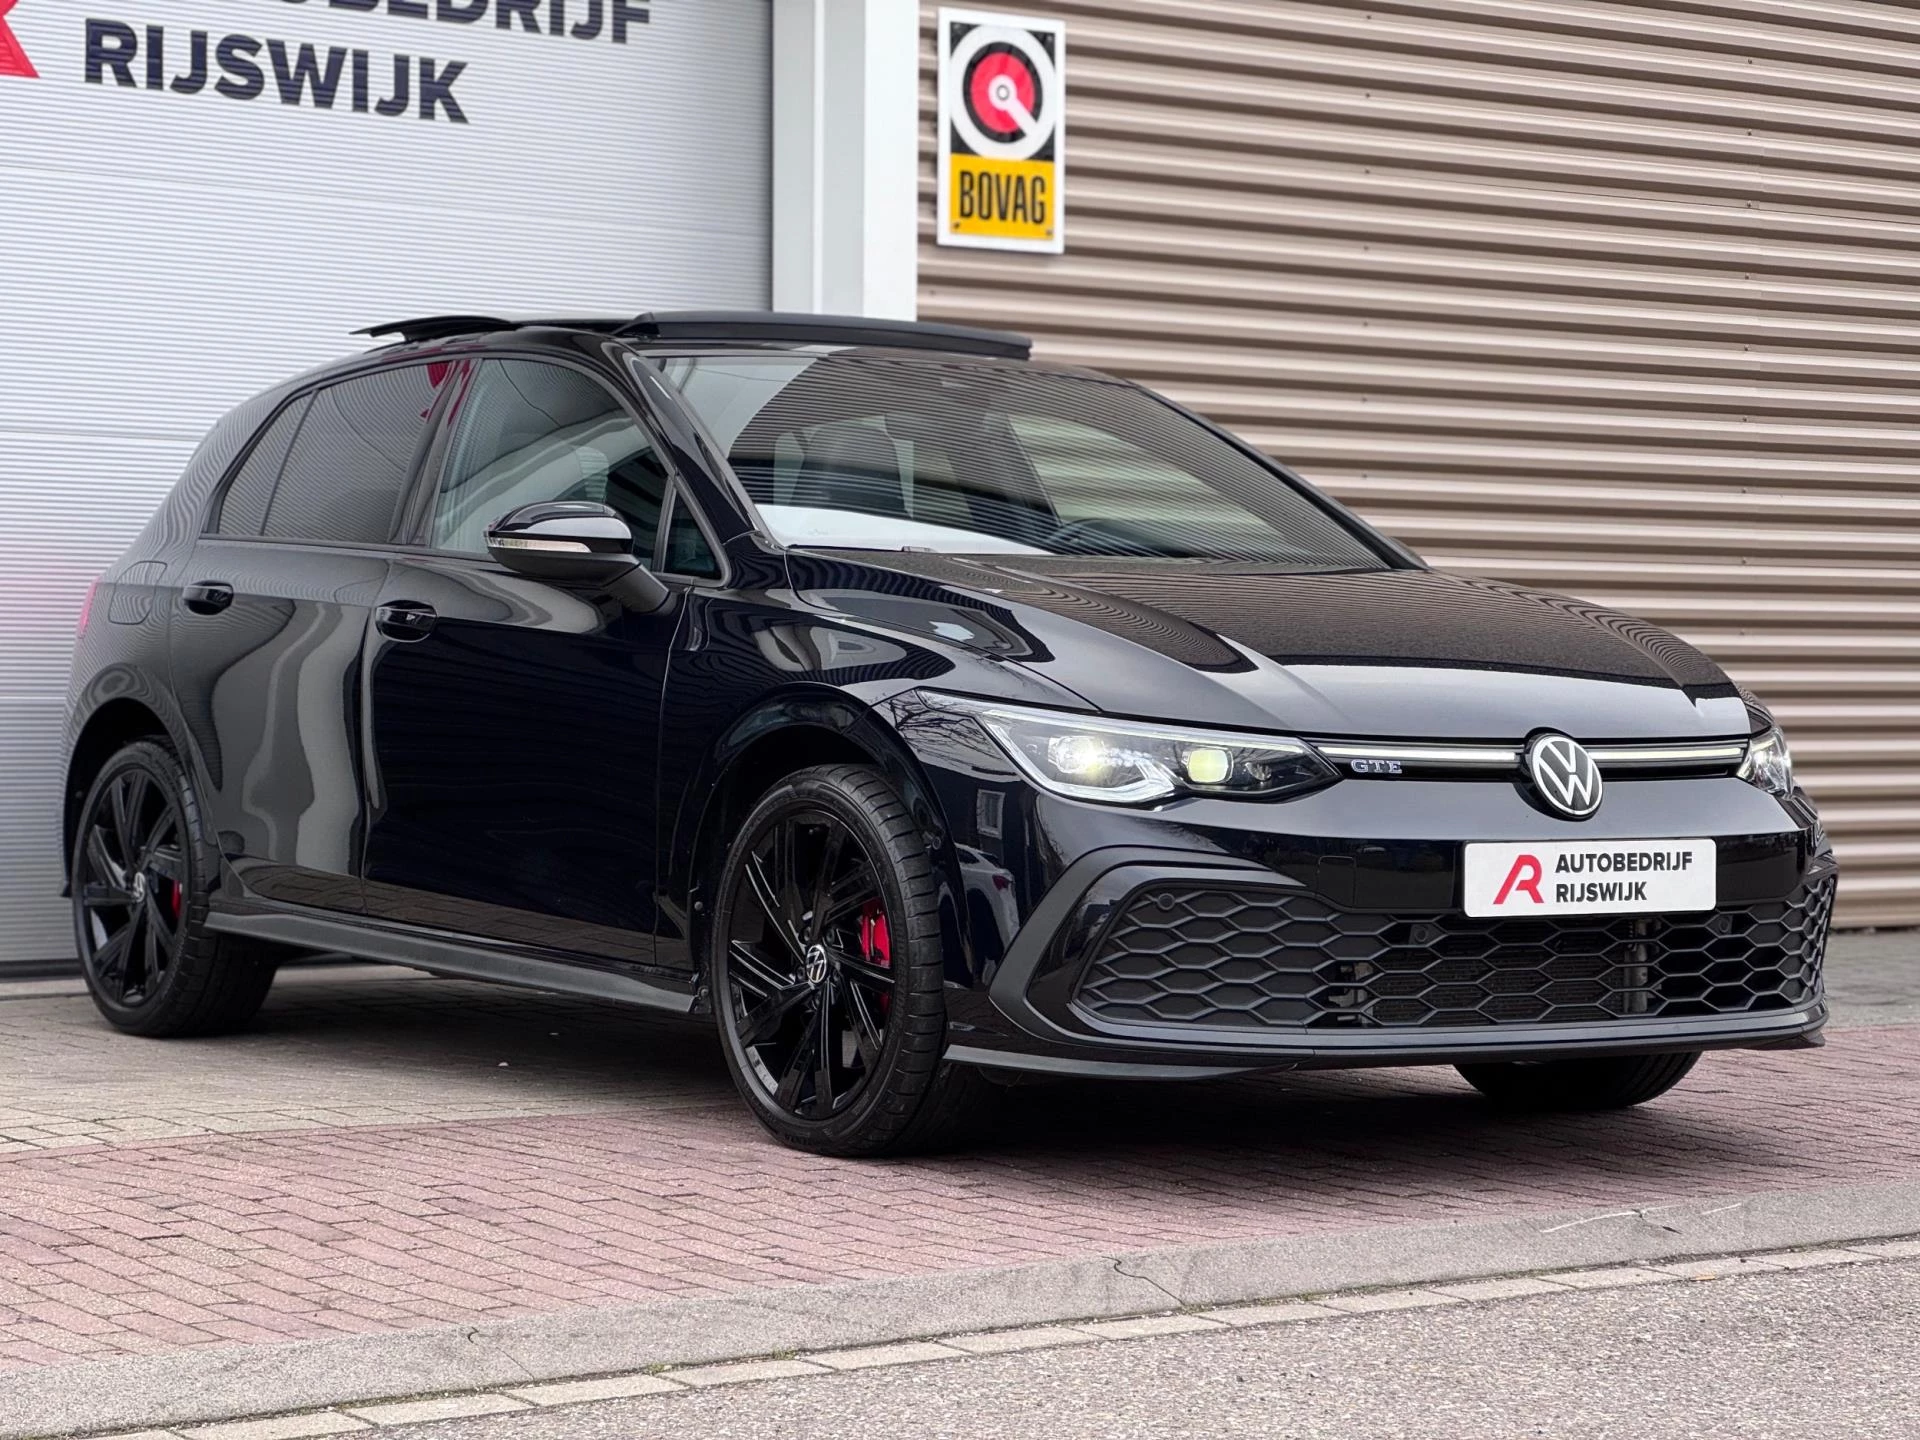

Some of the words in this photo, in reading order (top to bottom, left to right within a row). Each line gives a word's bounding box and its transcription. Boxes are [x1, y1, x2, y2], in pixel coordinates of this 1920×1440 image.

[85, 18, 469, 124] RIJSWIJK
[960, 171, 1045, 224] BOVAG
[1351, 759, 1402, 774] GTE
[1555, 852, 1693, 873] AUTOBEDRIJF
[1556, 882, 1647, 903] RIJSWIJK
